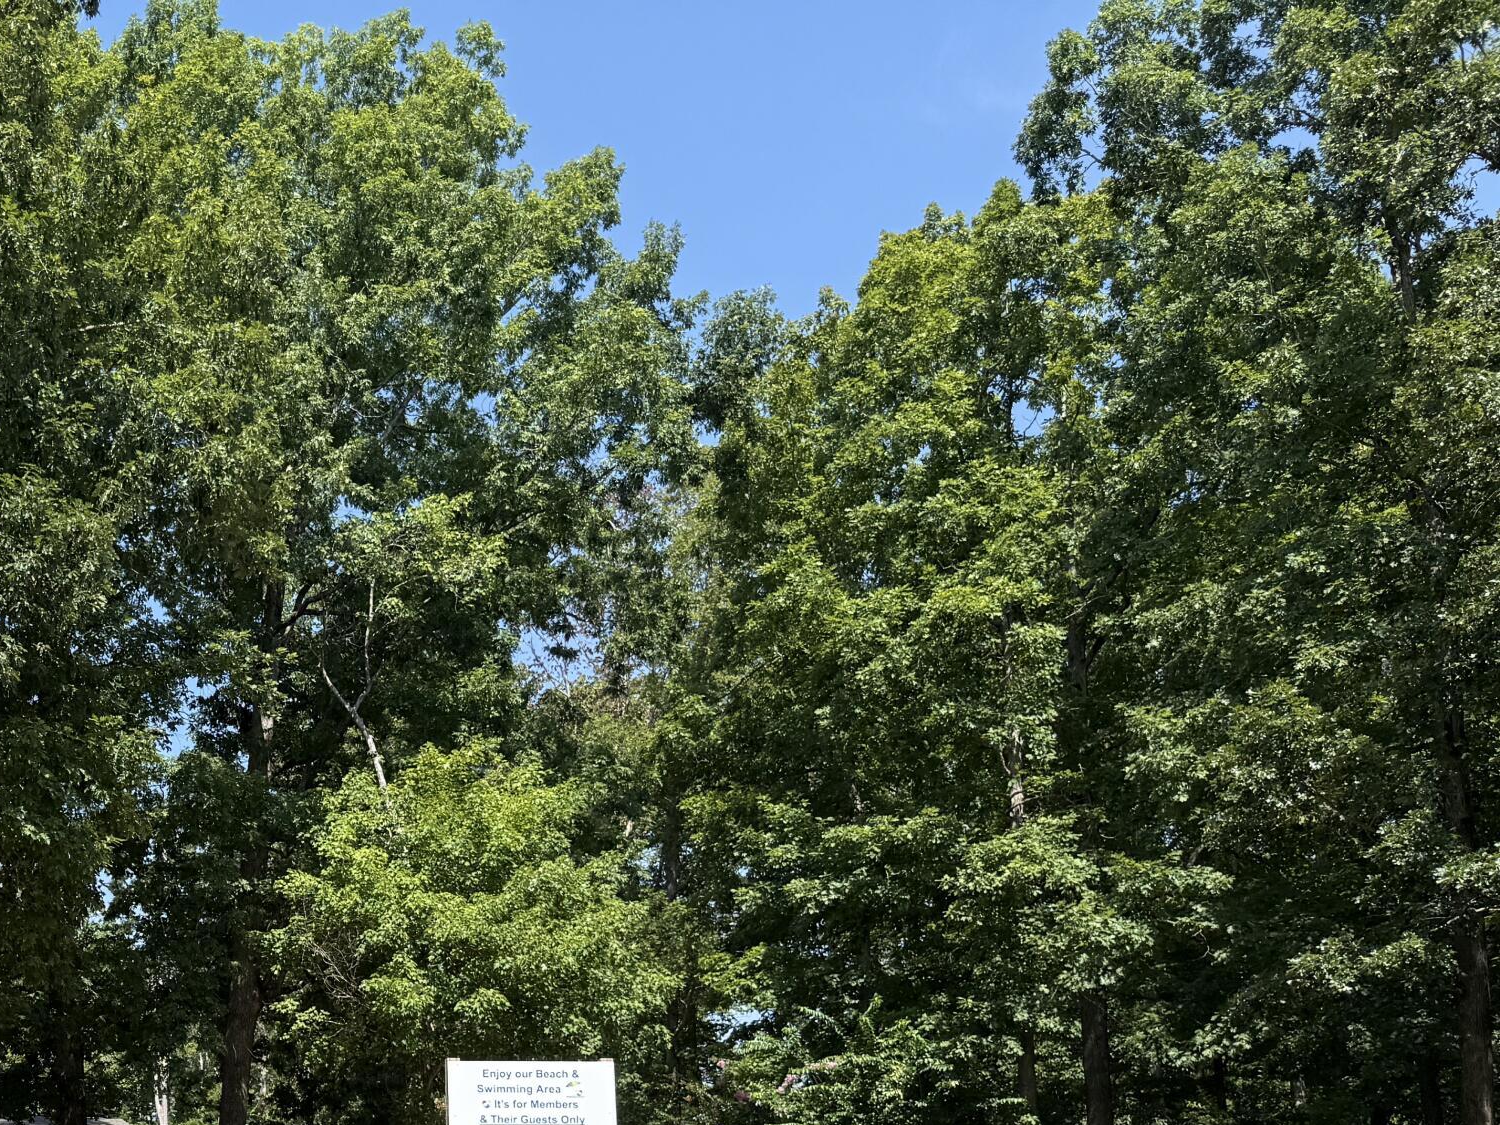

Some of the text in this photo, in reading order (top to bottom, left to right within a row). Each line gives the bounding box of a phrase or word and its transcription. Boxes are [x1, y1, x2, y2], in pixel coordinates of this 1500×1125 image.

[483, 1070, 512, 1080] Enjoy
[536, 1070, 569, 1079] Beach
[572, 1070, 580, 1079] &
[478, 1085, 561, 1096] Swimming Area
[495, 1100, 579, 1109] It's for Members
[480, 1115, 585, 1125] & Their Guests Only
